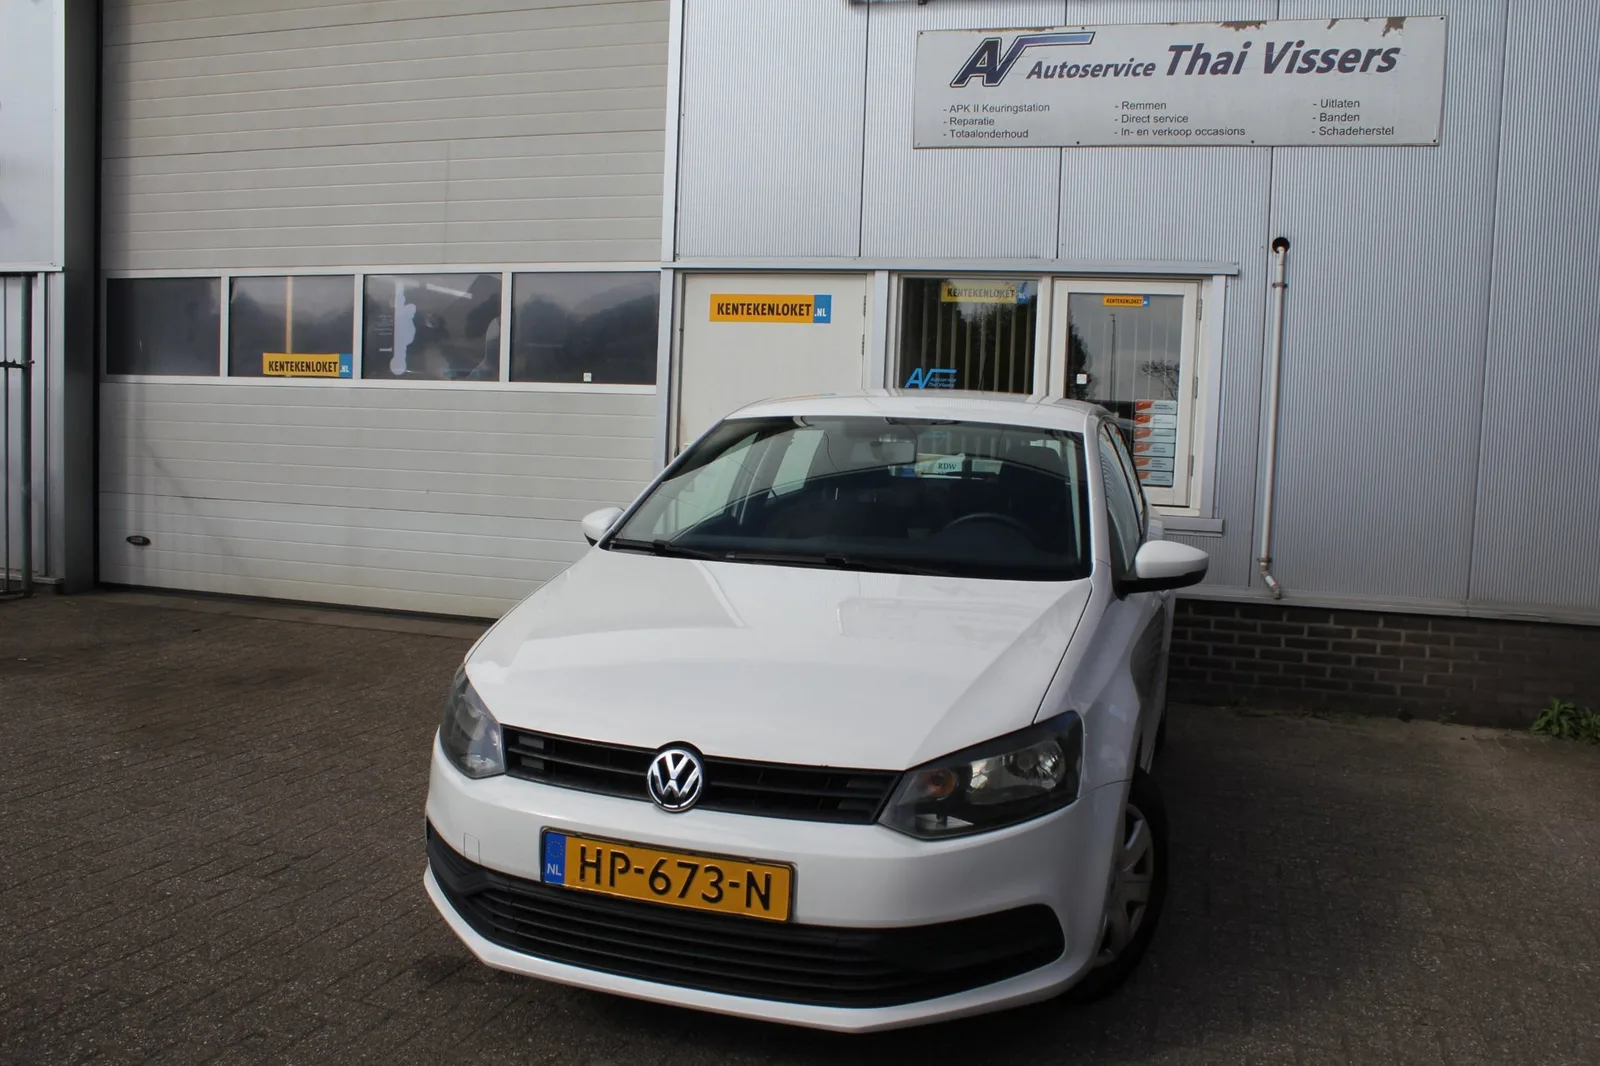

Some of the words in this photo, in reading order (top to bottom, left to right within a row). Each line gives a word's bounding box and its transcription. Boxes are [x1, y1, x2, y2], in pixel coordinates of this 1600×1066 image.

[1026, 57, 1156, 79] Autoservice
[1166, 41, 1252, 76] Thai
[1263, 40, 1401, 75] Vissers
[949, 104, 971, 113] APK
[982, 103, 1050, 115] Keuringstation
[1121, 101, 1167, 110] Remmen
[1320, 99, 1360, 108] Uitlaten
[949, 117, 995, 127] Reparatie
[1121, 114, 1151, 124] Direct
[1153, 114, 1189, 124] service
[1319, 112, 1360, 122] Banden
[950, 129, 1029, 139] Totaalonderhoud
[1136, 128, 1149, 136] en
[1152, 126, 1192, 138] verkoop
[1195, 126, 1246, 136] occasions
[1318, 126, 1394, 136] Schadeherstel
[717, 302, 812, 316] KENTEKENLOKET
[268, 360, 338, 372] KENTEKENLOKET
[547, 863, 562, 876] NL
[579, 844, 773, 911] HP-673-N
